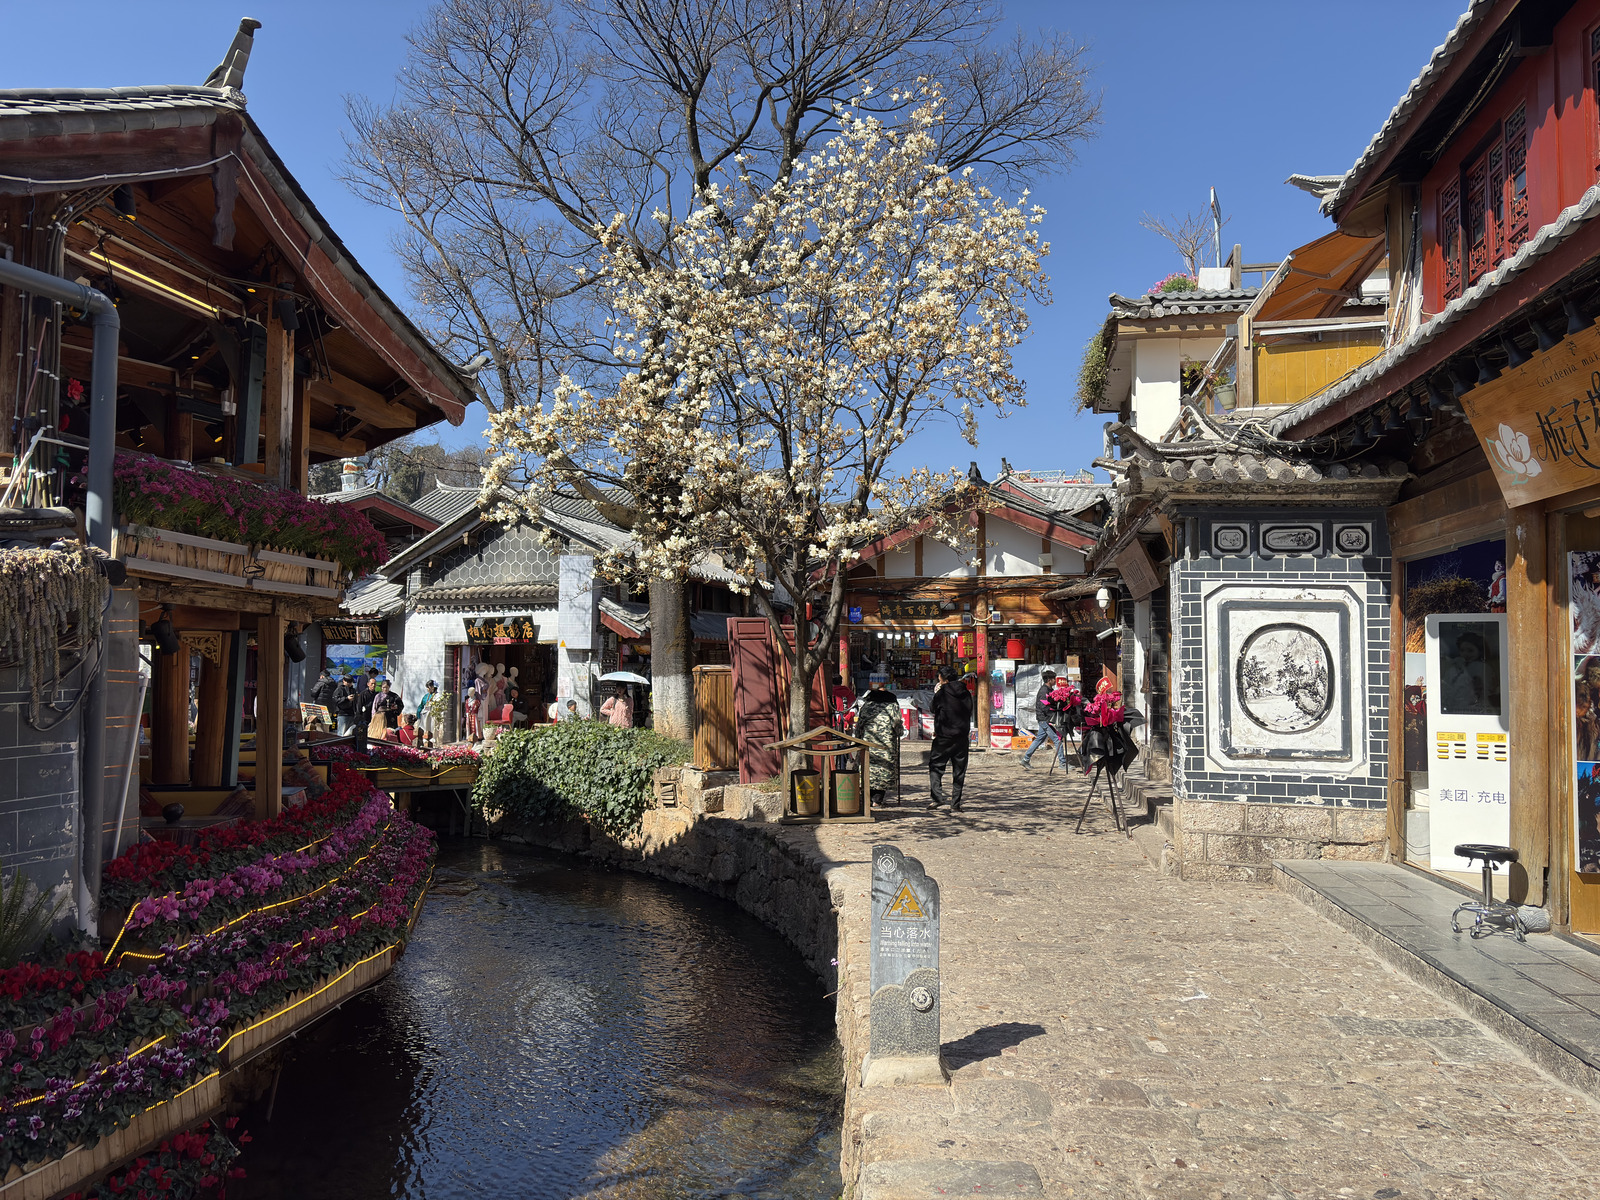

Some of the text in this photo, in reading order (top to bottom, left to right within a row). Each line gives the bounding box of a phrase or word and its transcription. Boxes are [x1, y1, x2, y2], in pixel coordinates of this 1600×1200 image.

[1537, 363, 1578, 388] Gardenia
[321, 624, 384, 640] 丽江中云社
[962, 632, 974, 656] 超市
[880, 926, 931, 939] 当心落水
